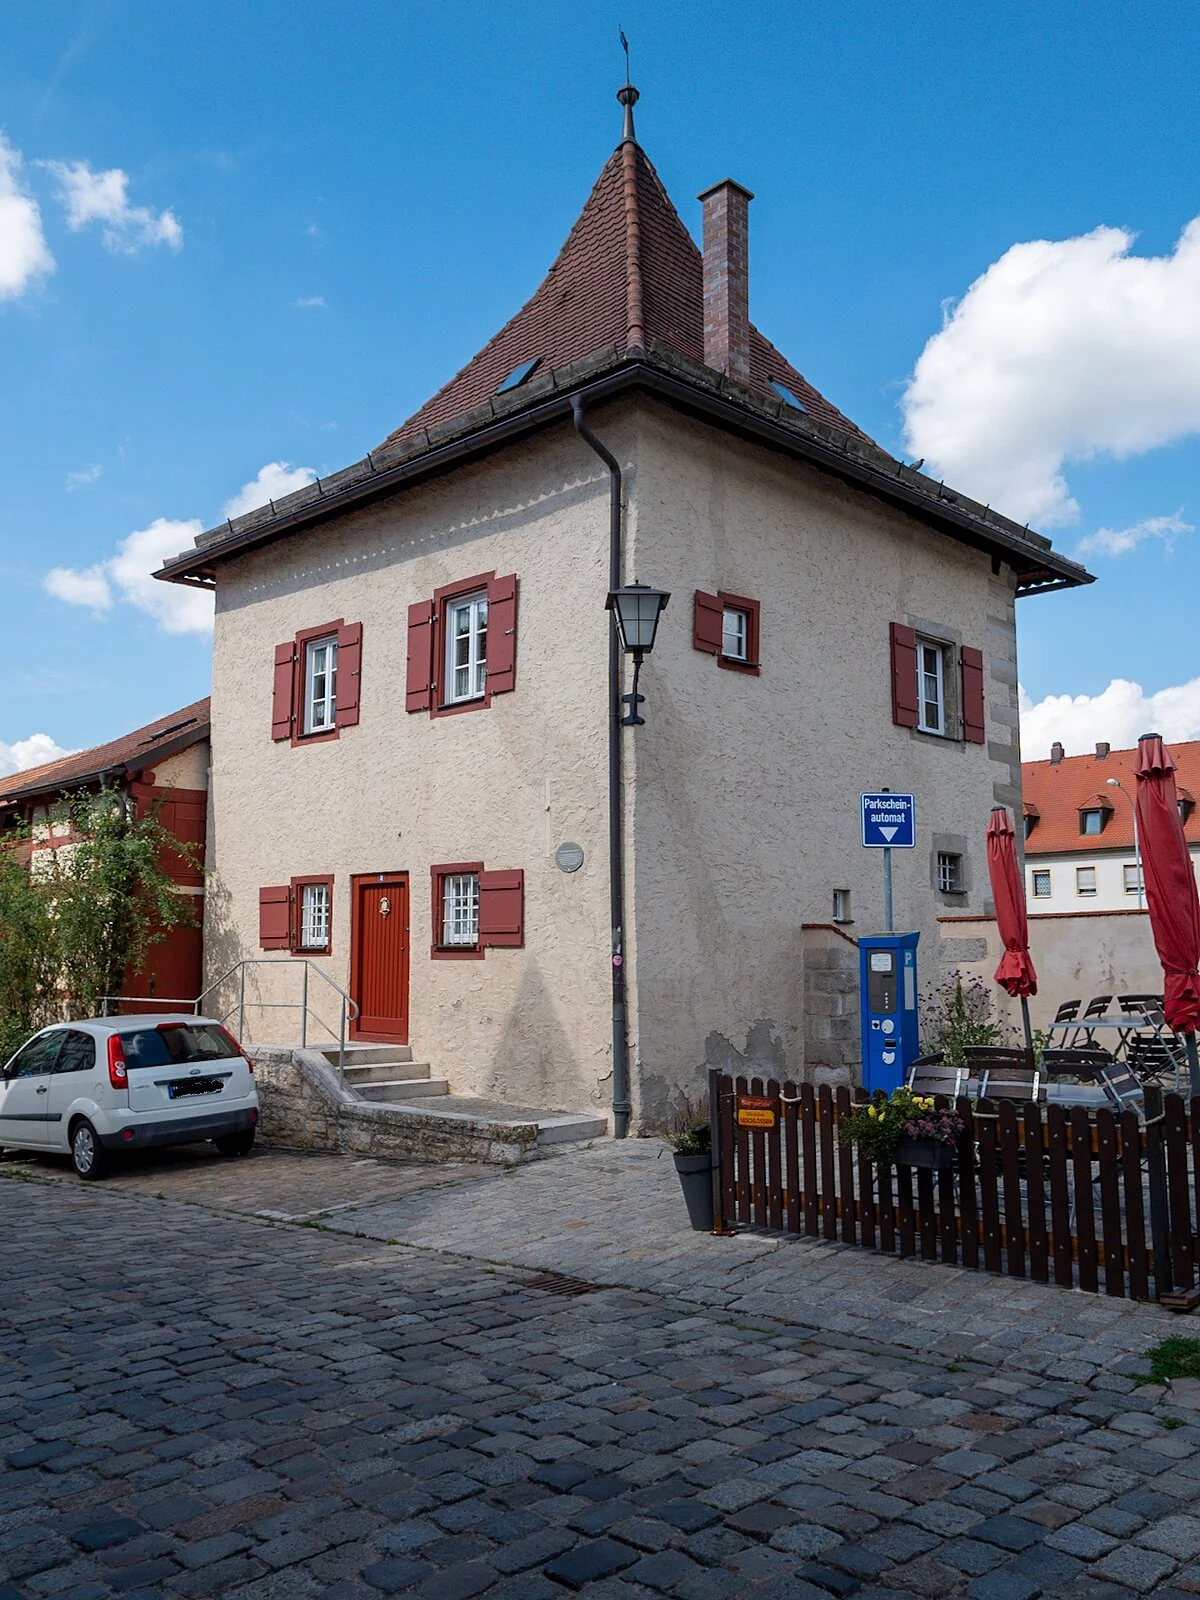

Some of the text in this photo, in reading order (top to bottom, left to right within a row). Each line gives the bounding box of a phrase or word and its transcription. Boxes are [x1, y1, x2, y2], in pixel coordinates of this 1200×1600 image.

[864, 798, 911, 809] Parkschein-
[871, 812, 905, 823] automat
[905, 952, 912, 965] P
